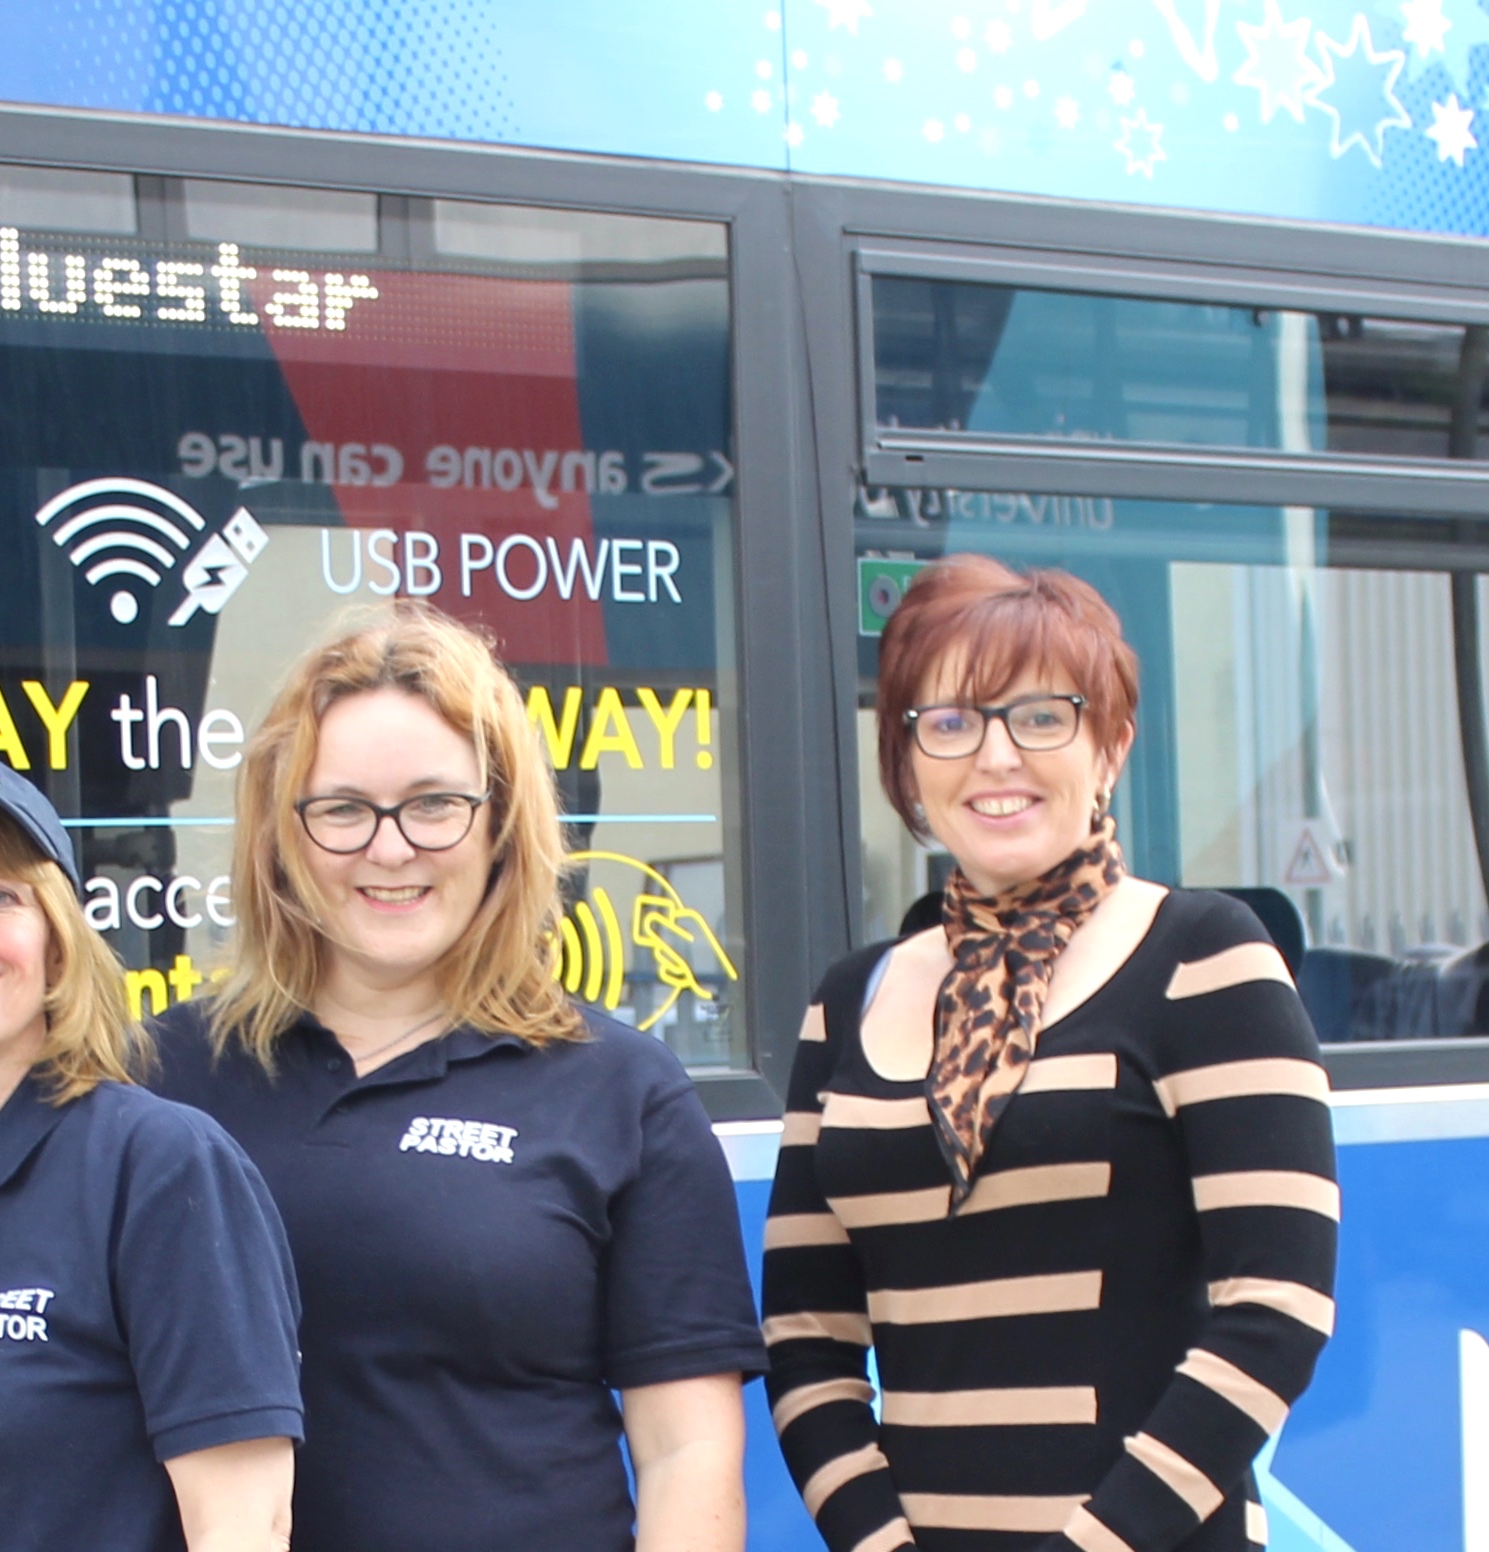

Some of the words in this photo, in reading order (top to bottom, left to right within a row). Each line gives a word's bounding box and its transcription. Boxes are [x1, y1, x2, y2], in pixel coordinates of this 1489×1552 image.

[320, 528, 442, 598] USB
[460, 532, 683, 603] POWER
[110, 674, 245, 770] the
[83, 874, 238, 932] acce
[124, 953, 233, 1022] nt
[399, 1133, 515, 1164] PASTOR
[408, 1116, 519, 1148] STREET
